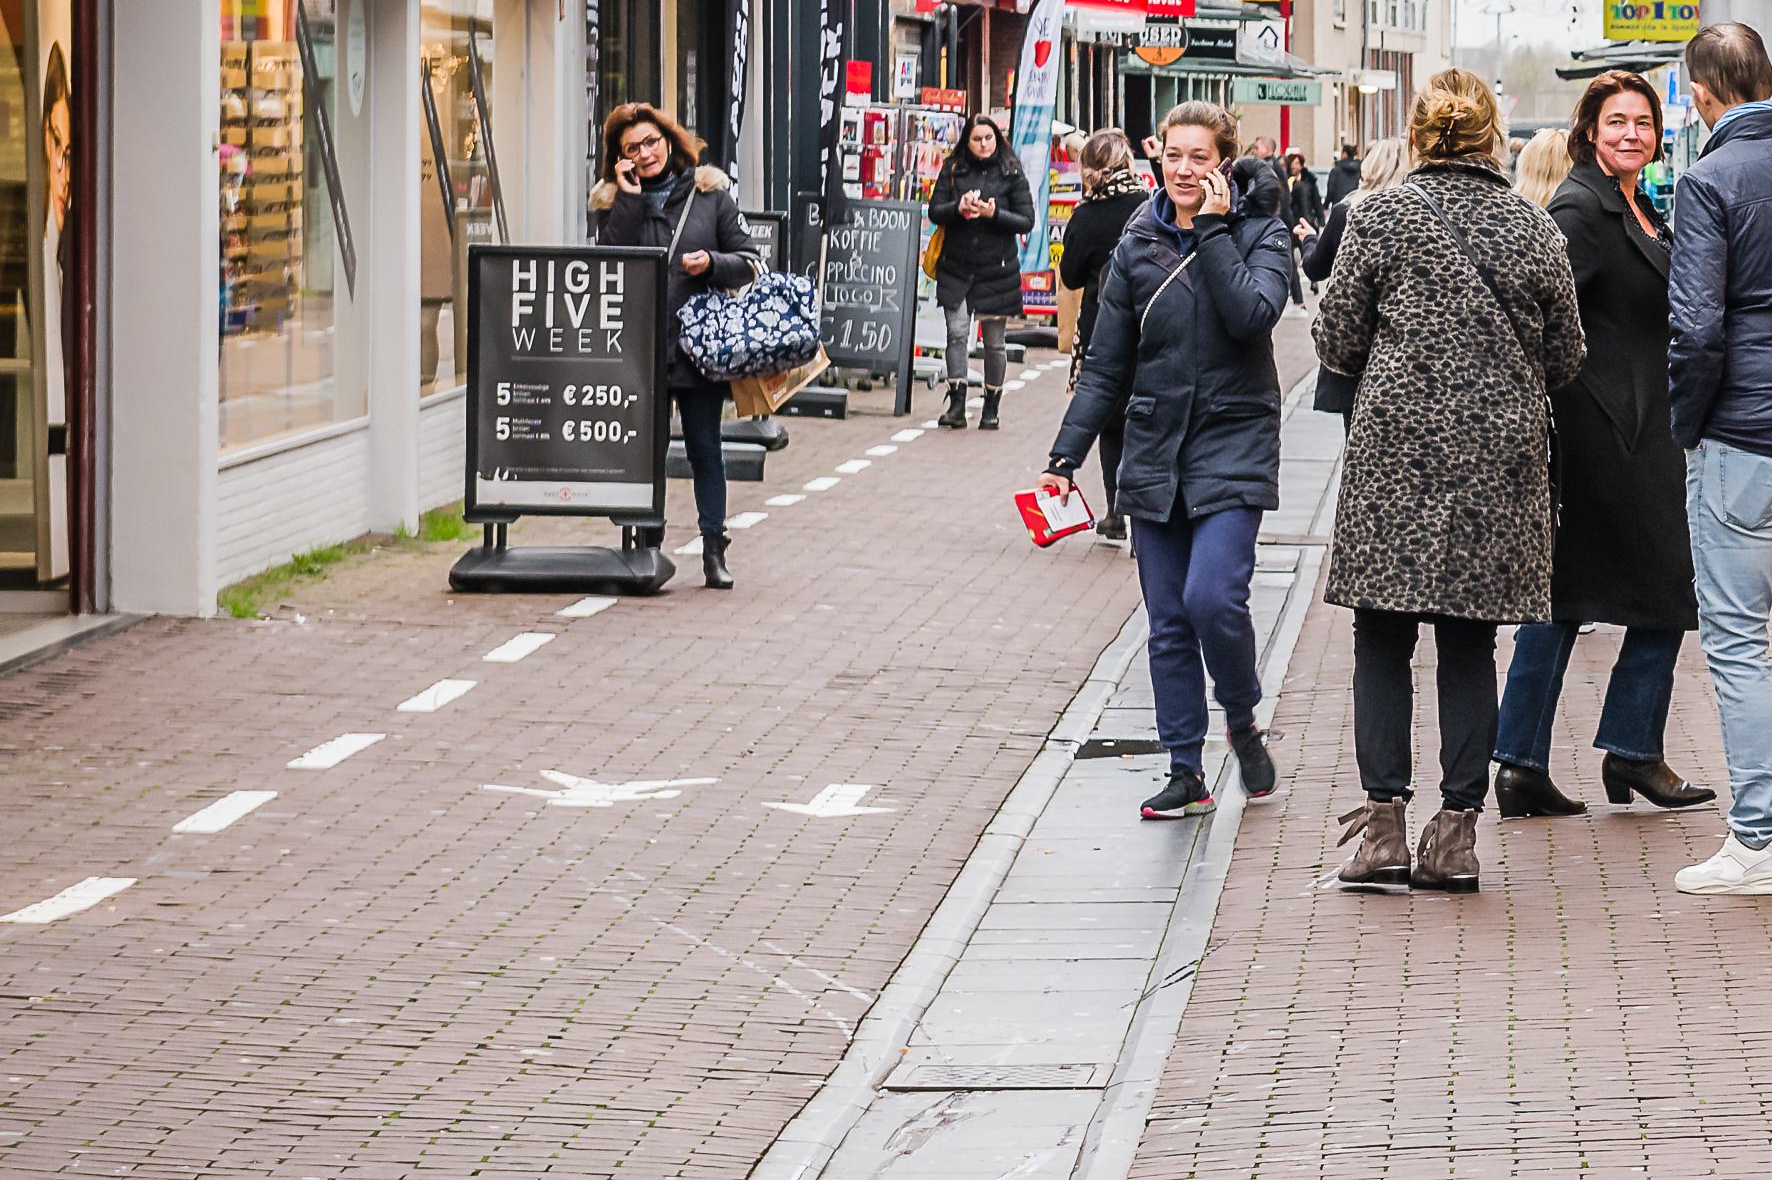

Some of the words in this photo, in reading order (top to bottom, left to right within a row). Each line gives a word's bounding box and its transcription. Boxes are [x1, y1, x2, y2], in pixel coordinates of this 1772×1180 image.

[1610, 4, 1650, 20] TOP
[1668, 4, 1700, 20] TO
[1139, 26, 1182, 41] USED
[749, 225, 773, 239] EEK
[831, 229, 883, 252] KOFFIE
[512, 259, 625, 293] HIGH
[806, 261, 897, 285] CPPUCCINO
[512, 292, 625, 329] FIVE
[512, 328, 623, 353] WEEK
[840, 318, 892, 353] 1,50
[497, 382, 511, 406] 5
[563, 384, 577, 406] €
[581, 384, 638, 409] 250,-
[496, 416, 510, 441] 5
[562, 420, 576, 442] €
[580, 420, 637, 445] 500,-
